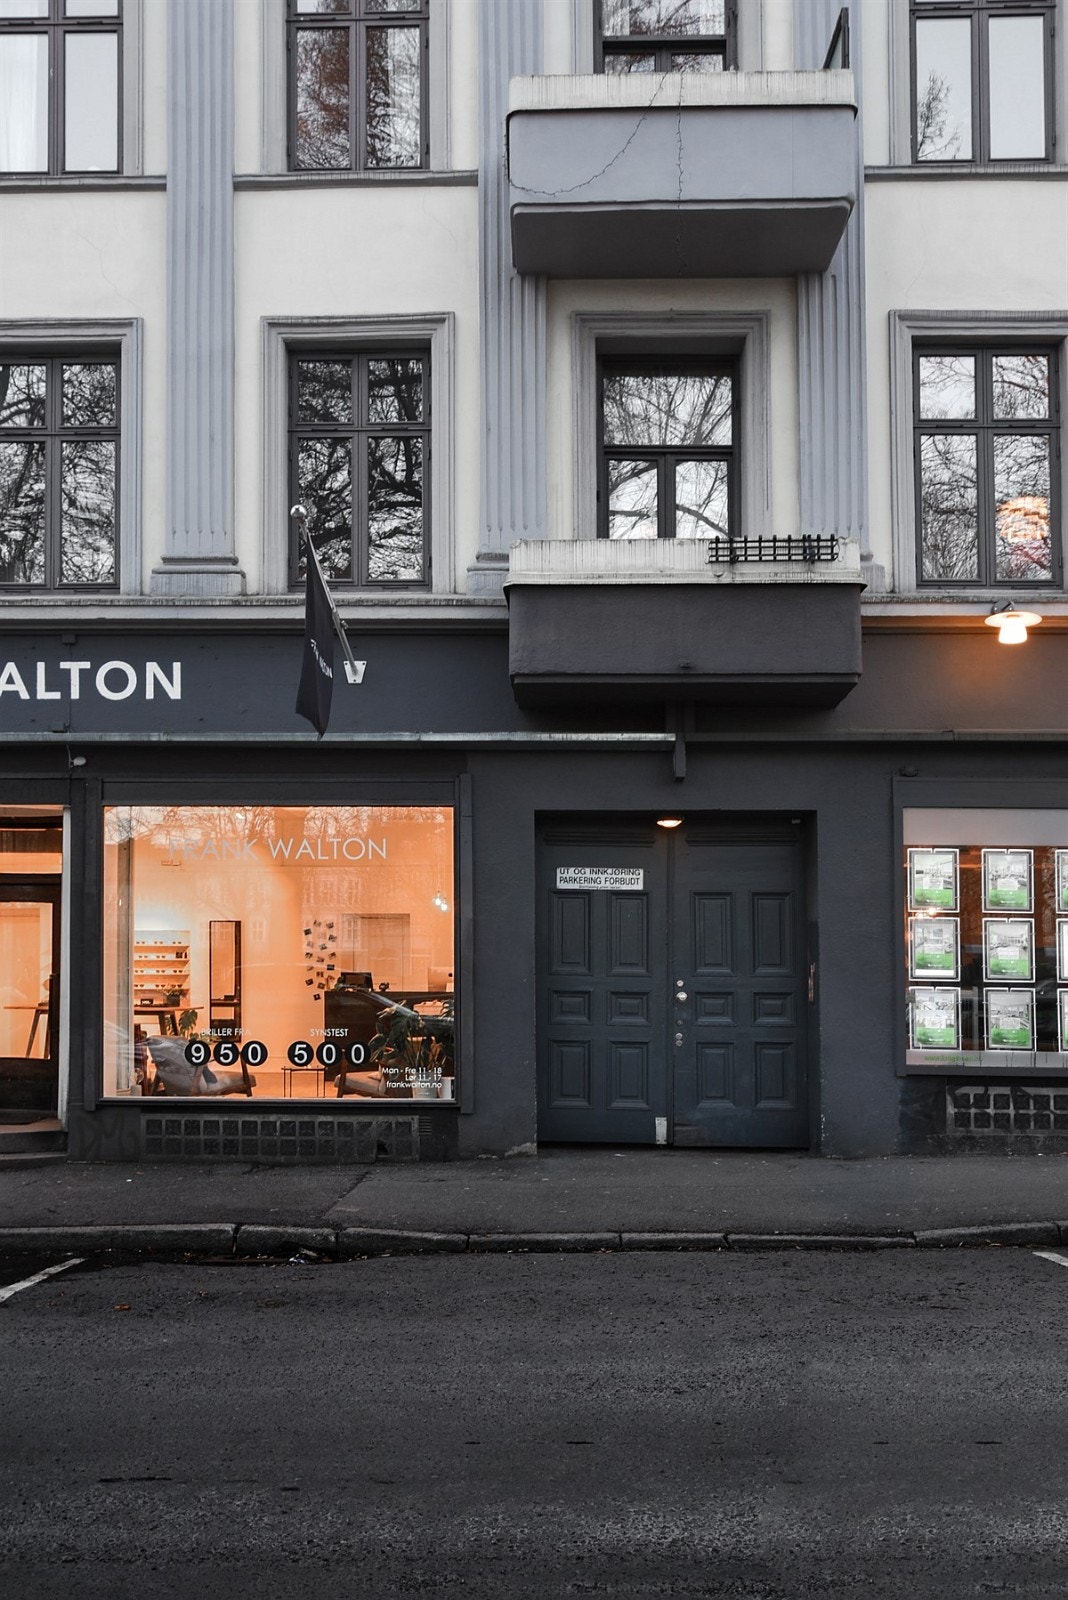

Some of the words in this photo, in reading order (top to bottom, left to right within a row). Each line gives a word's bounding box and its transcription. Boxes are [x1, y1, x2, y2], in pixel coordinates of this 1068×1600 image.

[0, 661, 182, 701] ALTON
[169, 838, 259, 860] FRANK
[267, 838, 388, 860] WALTON
[589, 868, 641, 876] INNKJØRING
[559, 876, 602, 885] PARKERING
[604, 877, 640, 885] FORBUDT
[201, 1028, 232, 1037] BRILLER
[309, 1028, 349, 1037] SYNSTEST
